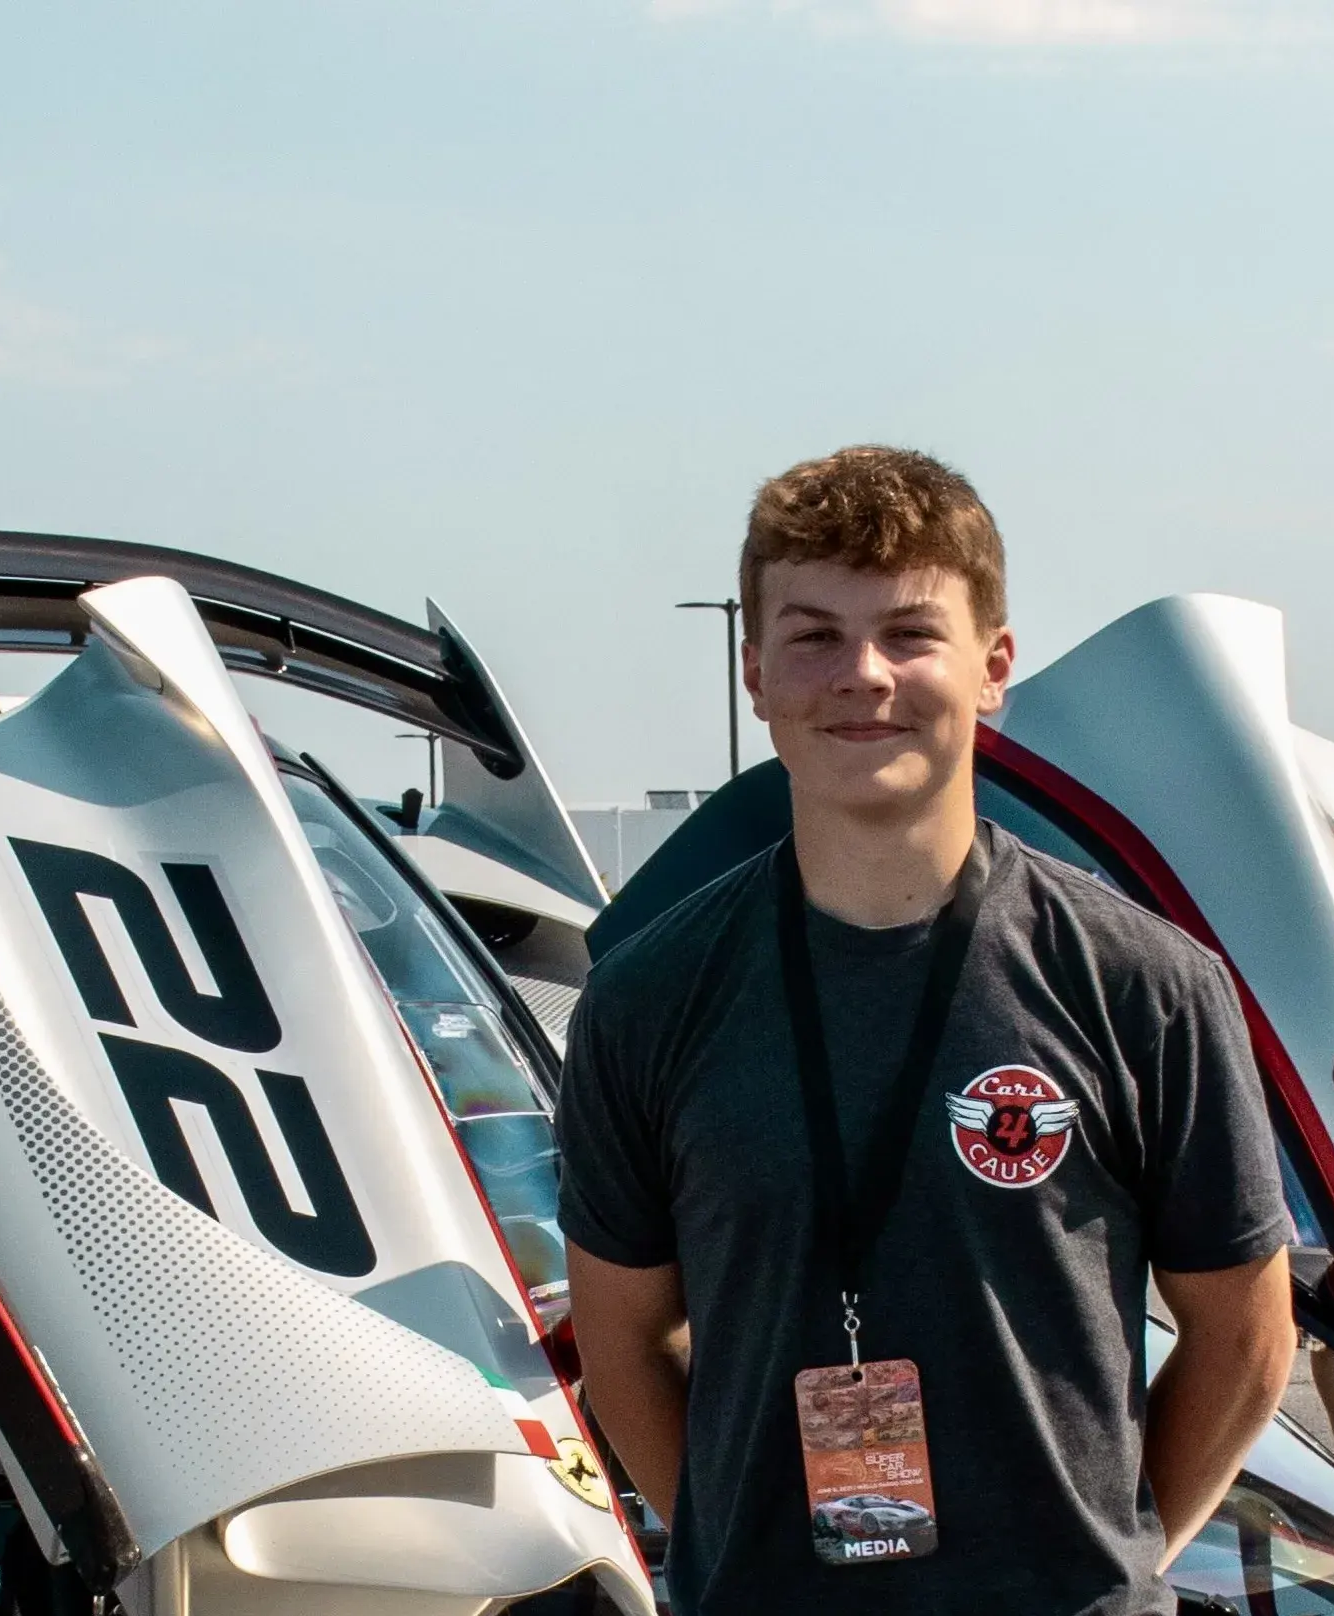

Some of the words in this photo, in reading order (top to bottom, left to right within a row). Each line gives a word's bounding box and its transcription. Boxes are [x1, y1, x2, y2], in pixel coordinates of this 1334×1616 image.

[6, 835, 377, 1278] 22
[979, 1077, 1047, 1098] Cars
[996, 1113, 1029, 1148] 4
[969, 1143, 1050, 1180] CAUSE
[865, 1452, 906, 1465] SUPER
[879, 1461, 904, 1472] CAR
[887, 1468, 923, 1480] SHOW
[844, 1537, 911, 1558] MEDIA
